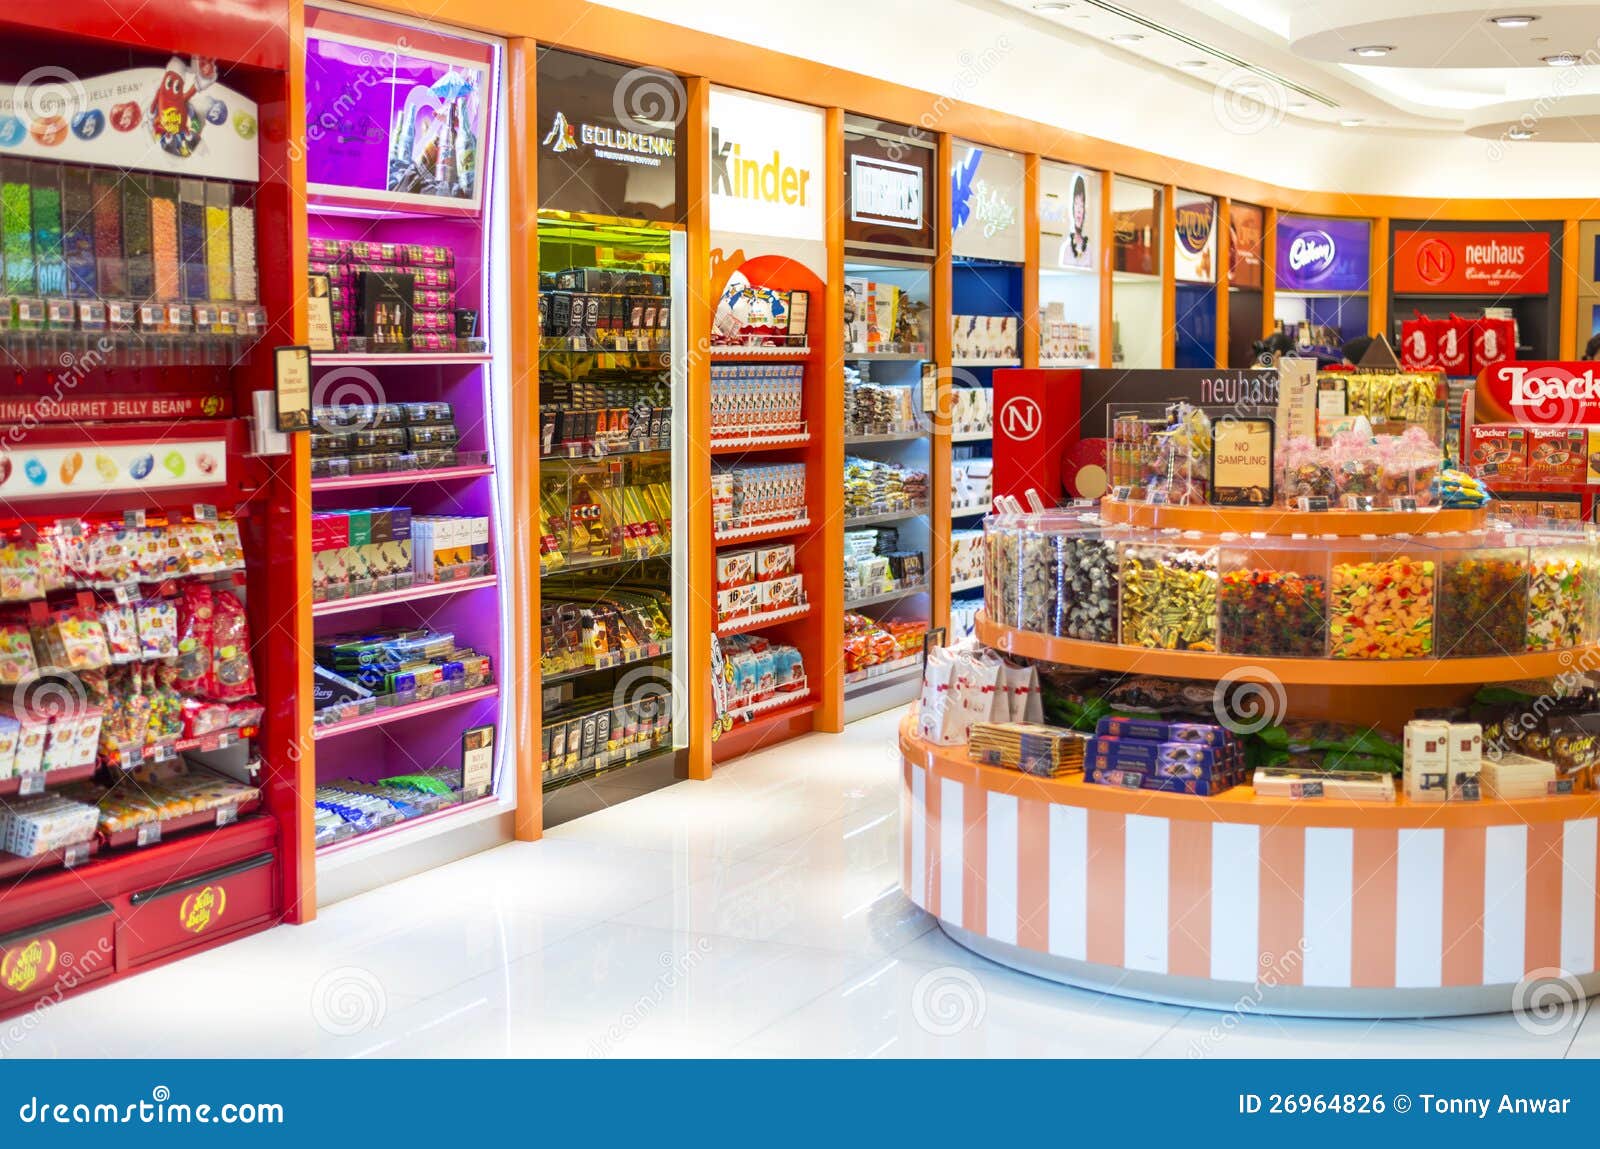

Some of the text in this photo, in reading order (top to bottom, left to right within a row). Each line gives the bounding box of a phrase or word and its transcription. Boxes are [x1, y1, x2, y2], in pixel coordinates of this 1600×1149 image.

[582, 124, 675, 157] GOLDKENN
[1465, 240, 1525, 264] neuhaus
[40, 402, 107, 417] GOURMET
[112, 400, 146, 415] JELLY
[1472, 427, 1507, 438] Loacker
[1530, 427, 1567, 439] Loacker
[1234, 441, 1249, 452] NO
[1216, 455, 1267, 466] SAMPLING
